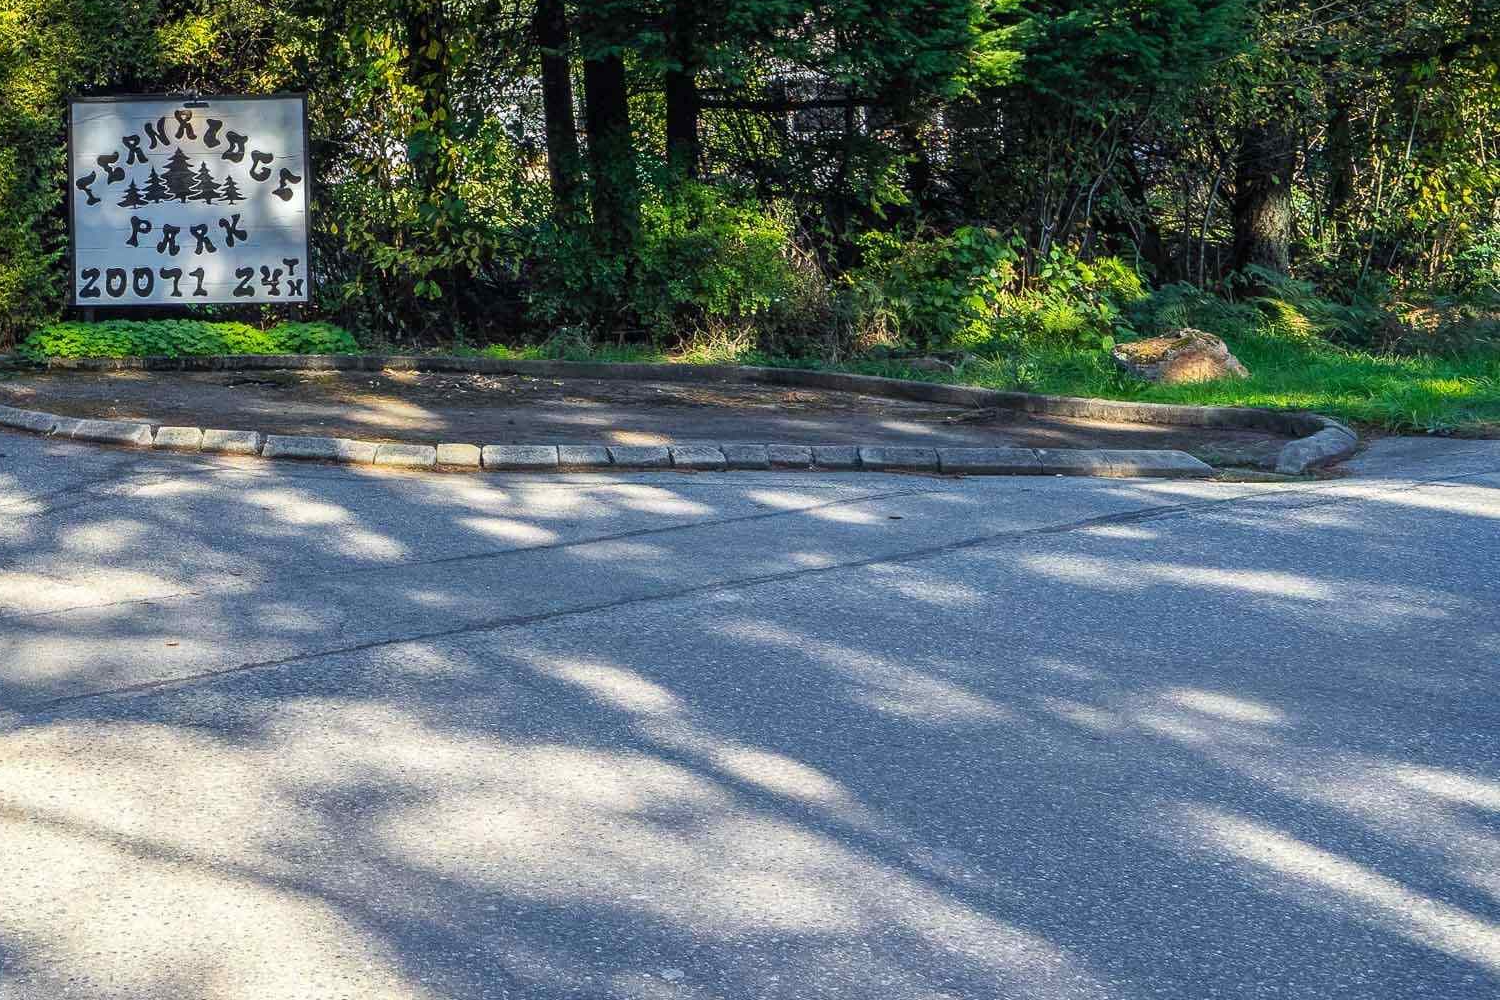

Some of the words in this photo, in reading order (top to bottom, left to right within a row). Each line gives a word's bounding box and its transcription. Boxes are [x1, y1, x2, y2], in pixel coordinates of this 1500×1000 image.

[76, 110, 301, 205] FERNRIDGE
[126, 214, 248, 256] PARK
[79, 267, 208, 298] 20071
